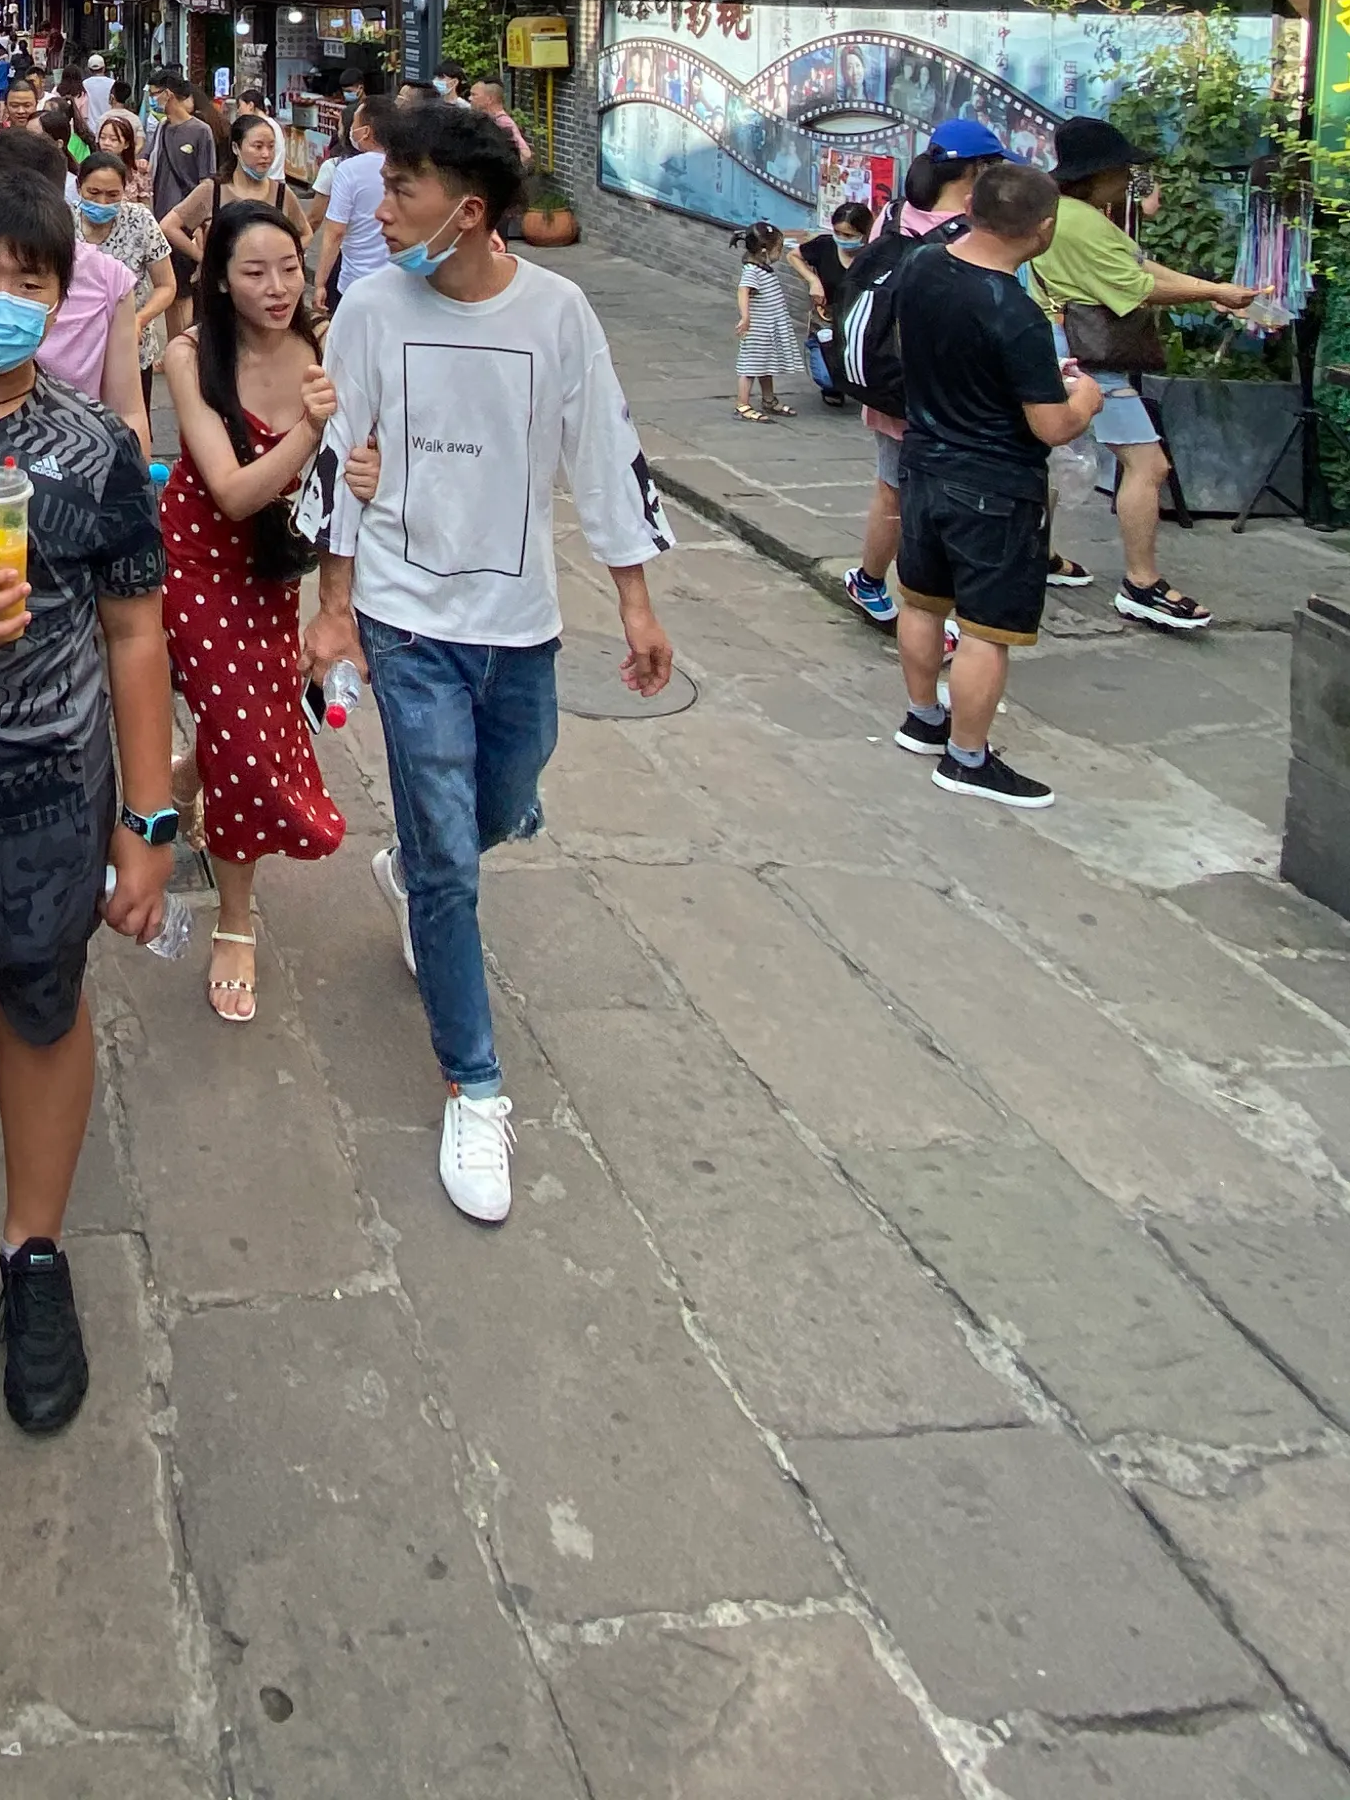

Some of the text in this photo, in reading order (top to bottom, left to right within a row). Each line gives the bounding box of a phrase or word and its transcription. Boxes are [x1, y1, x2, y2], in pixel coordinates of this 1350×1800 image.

[412, 435, 483, 458] Walk away
[30, 463, 63, 481] adidas
